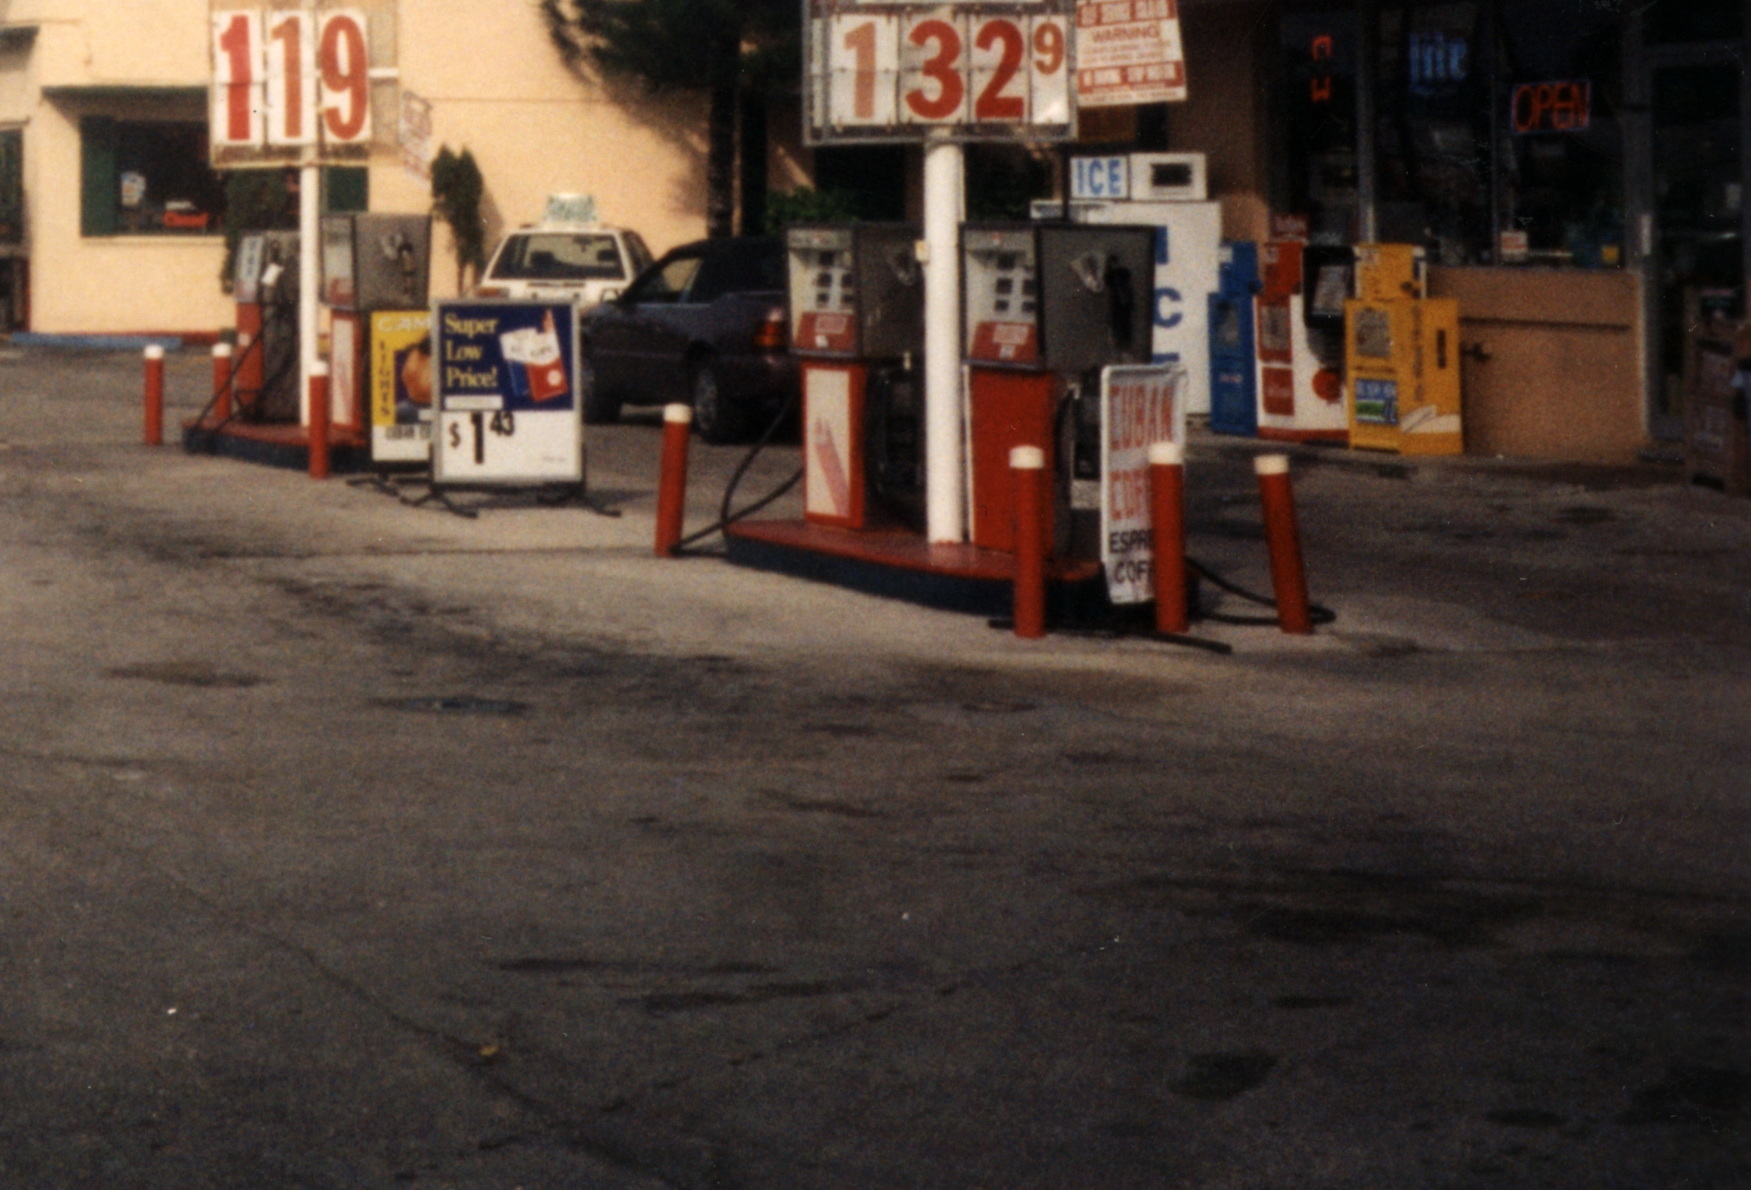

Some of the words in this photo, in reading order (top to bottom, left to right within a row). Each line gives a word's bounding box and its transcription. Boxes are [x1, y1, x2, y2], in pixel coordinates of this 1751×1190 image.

[1092, 24, 1160, 42] WARNING
[220, 14, 368, 141] 119
[1513, 82, 1588, 132] OPEN
[1077, 160, 1120, 195] ICE
[445, 314, 498, 340] Super
[446, 340, 483, 361] Low
[446, 365, 498, 388] Price!
